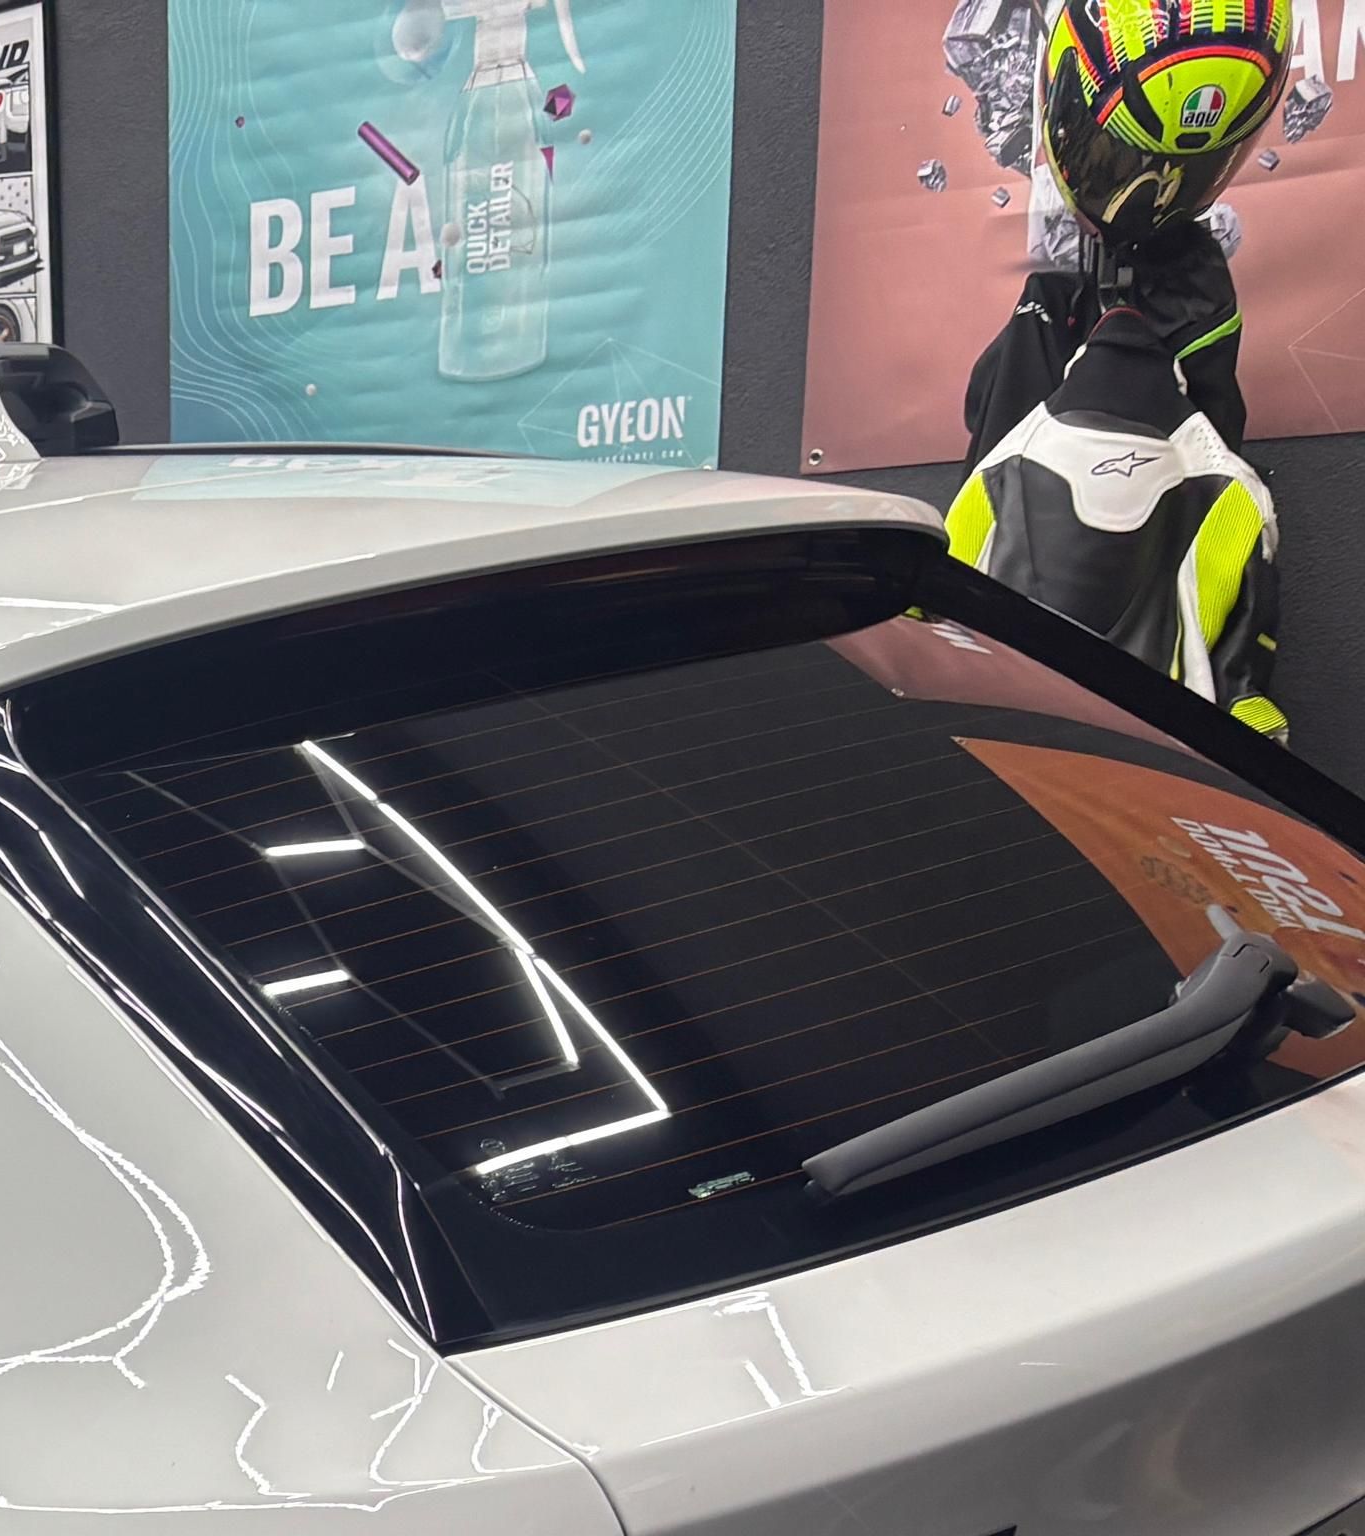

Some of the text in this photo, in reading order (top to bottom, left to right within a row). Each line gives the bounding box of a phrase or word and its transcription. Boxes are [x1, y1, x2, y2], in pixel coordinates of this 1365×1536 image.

[249, 175, 442, 317] BE A
[466, 200, 488, 275] QUICK
[489, 160, 514, 272] DETAILER
[577, 396, 686, 448] GYEON
